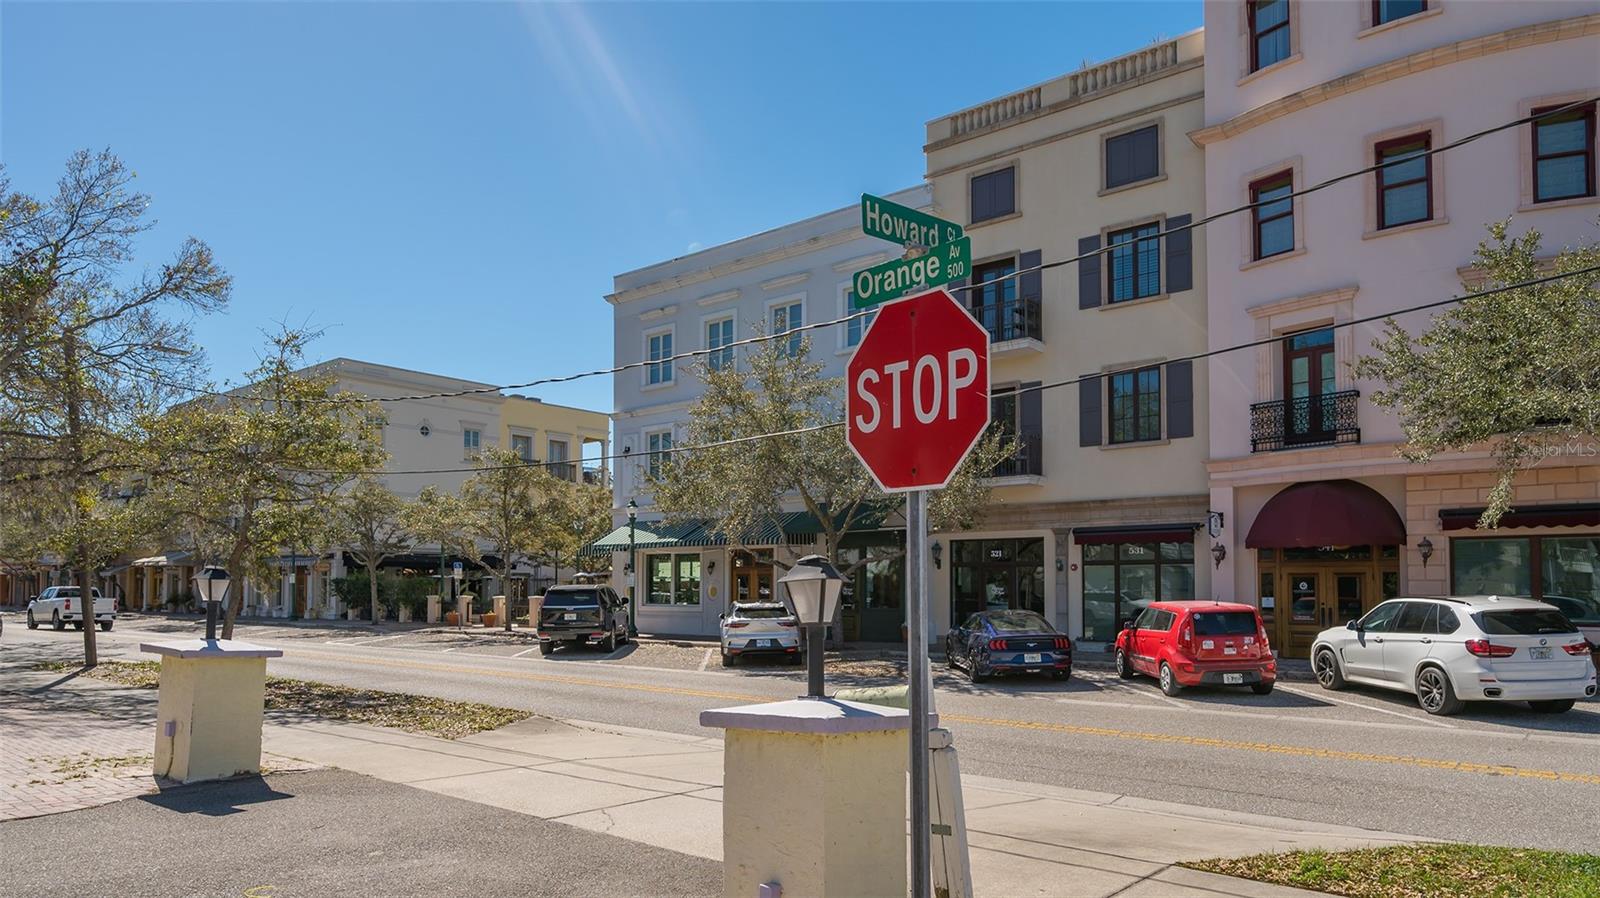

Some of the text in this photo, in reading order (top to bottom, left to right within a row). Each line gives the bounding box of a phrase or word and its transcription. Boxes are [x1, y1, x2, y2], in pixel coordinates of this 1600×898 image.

[866, 200, 955, 247] Howard Ct
[857, 245, 960, 299] Orange Av
[947, 261, 964, 278] 500
[855, 348, 978, 434] STOP
[1128, 546, 1144, 554] 531
